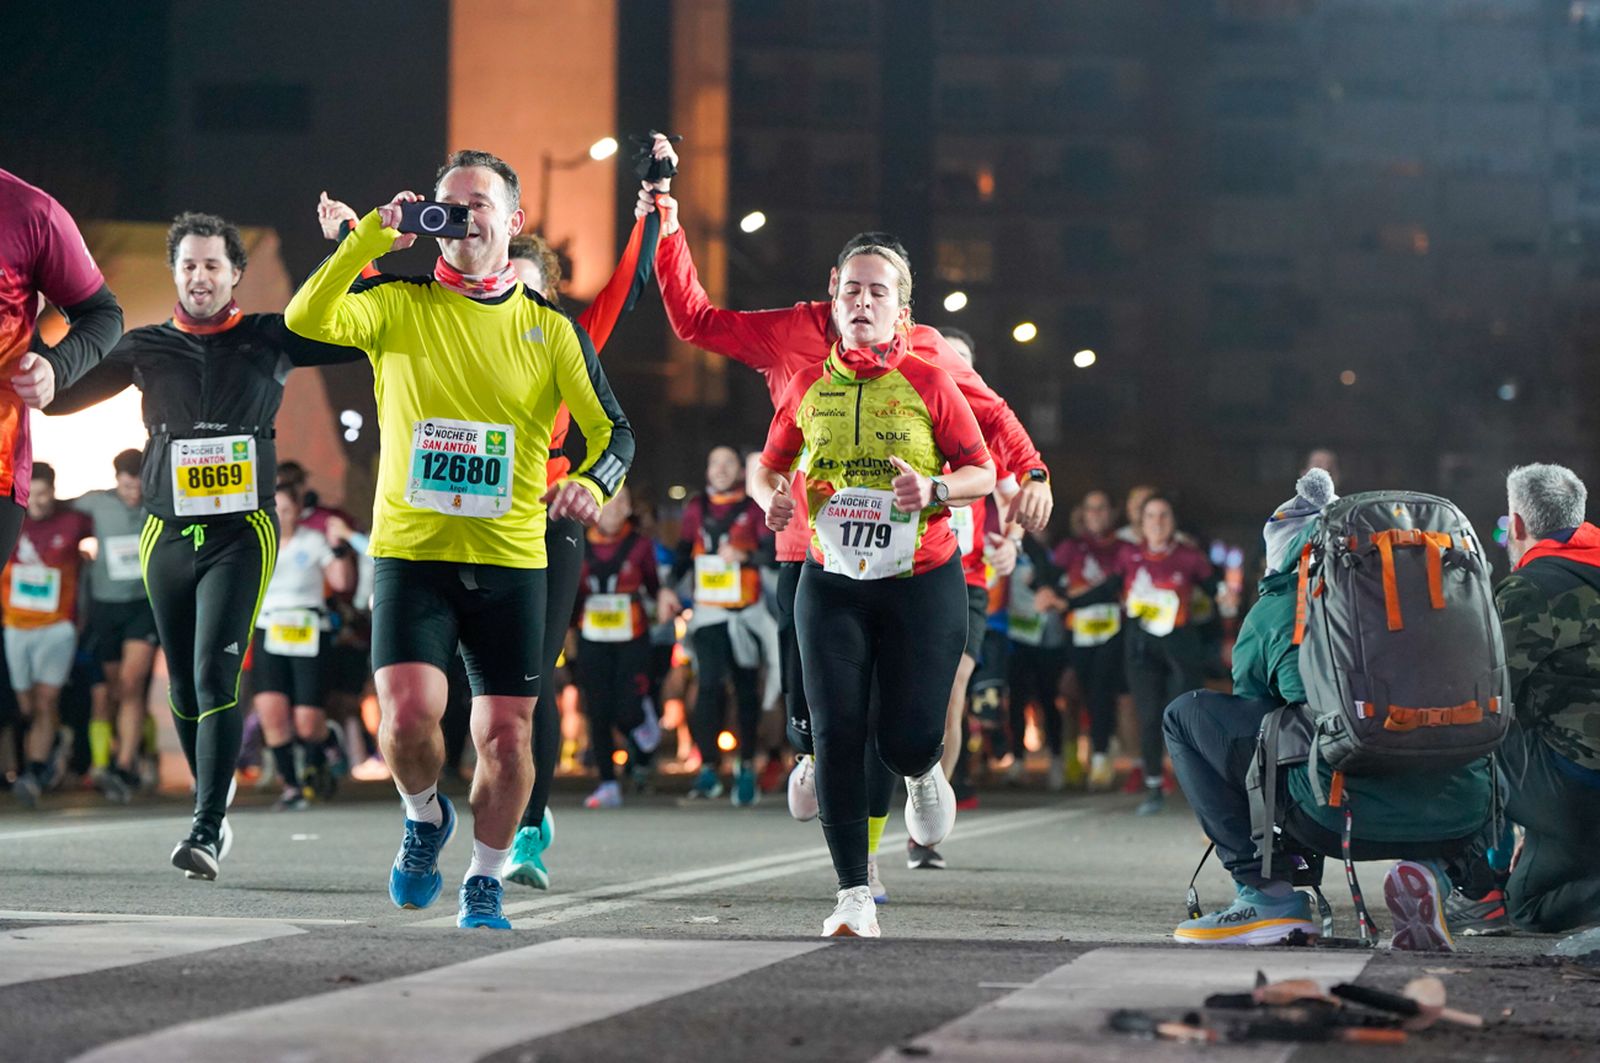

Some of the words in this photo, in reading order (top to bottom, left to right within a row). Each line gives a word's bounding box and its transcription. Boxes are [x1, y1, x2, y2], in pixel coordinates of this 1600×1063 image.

[435, 429, 465, 441] NOCHE
[466, 432, 479, 442] DE
[885, 431, 911, 441] DUE
[190, 446, 213, 456] NOCHE
[215, 446, 224, 454] DE
[422, 439, 443, 451] SAN
[443, 441, 477, 454] ANTÓN
[181, 458, 196, 466] SAN
[422, 452, 501, 486] 12680
[188, 464, 242, 488] 8669
[840, 497, 869, 508] NOCHE
[870, 499, 883, 510] DE
[827, 507, 849, 518] SAN
[849, 508, 882, 521] ANTÓN
[839, 520, 892, 549] 1779
[1217, 906, 1258, 924] HOKA
